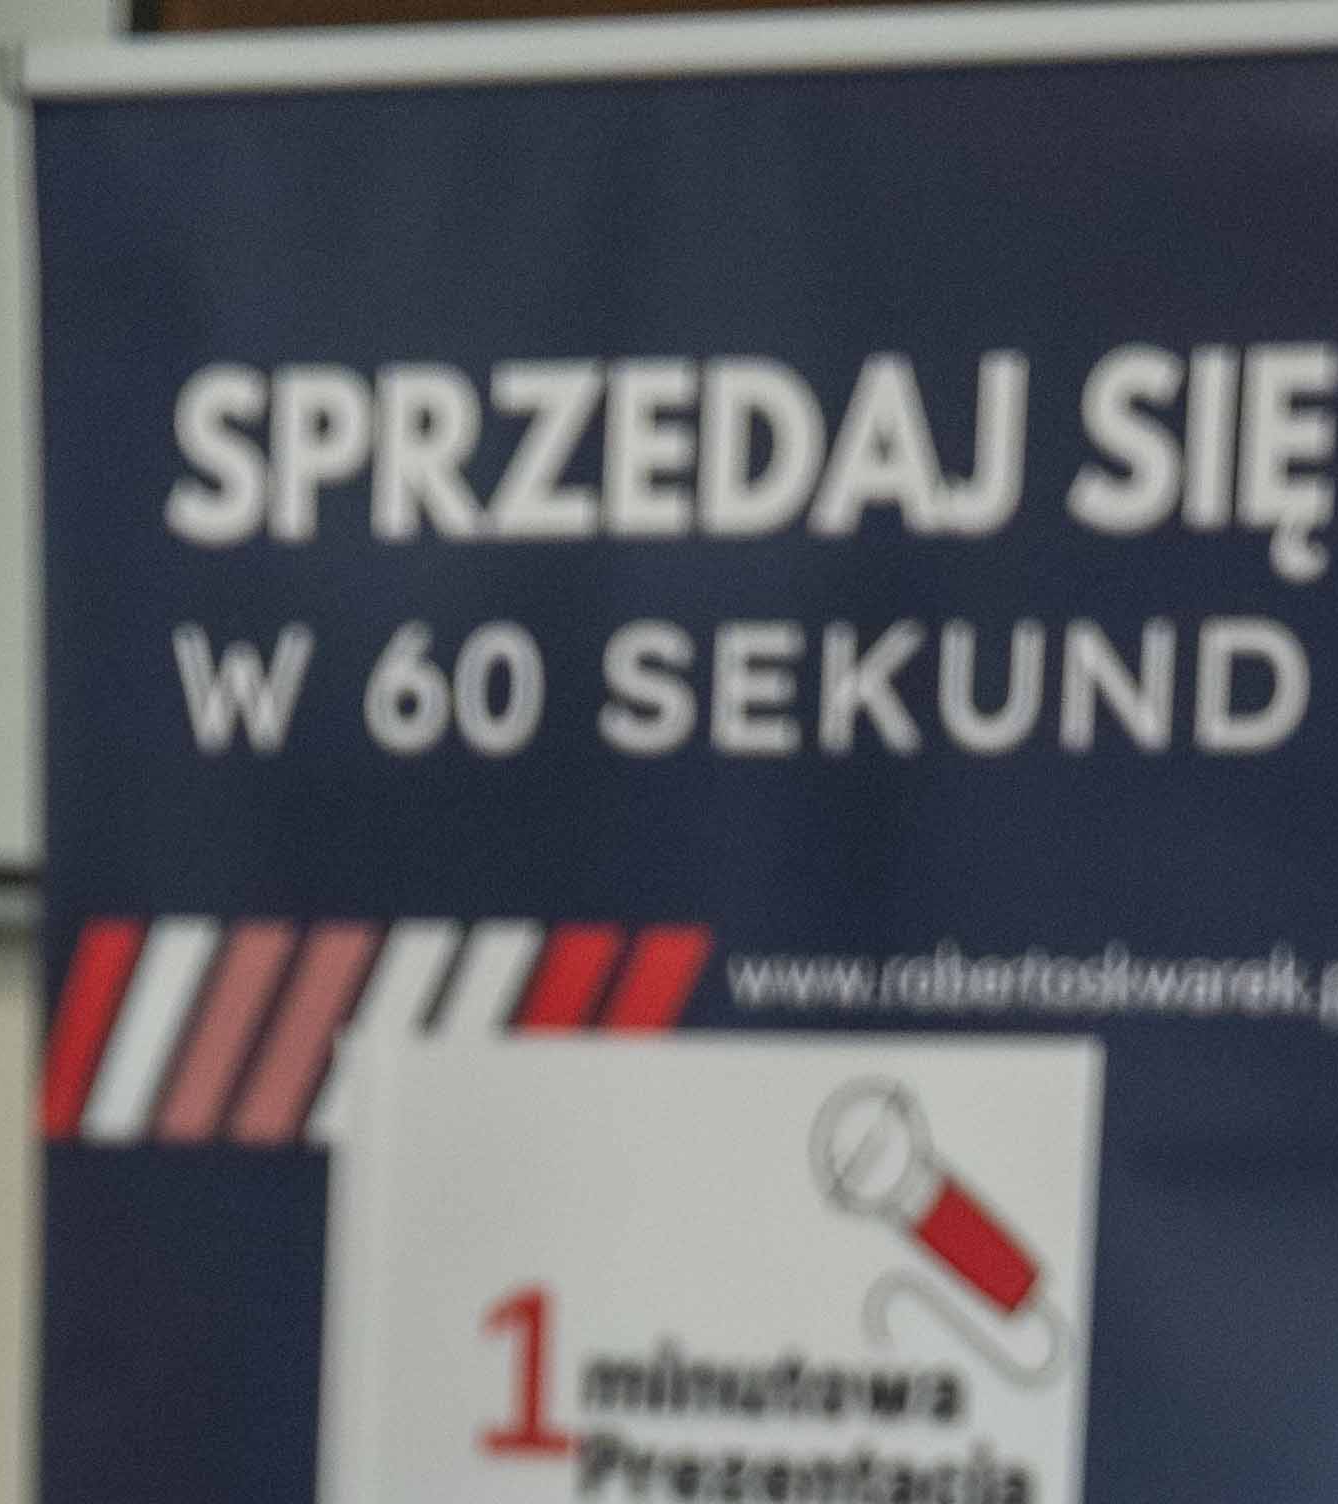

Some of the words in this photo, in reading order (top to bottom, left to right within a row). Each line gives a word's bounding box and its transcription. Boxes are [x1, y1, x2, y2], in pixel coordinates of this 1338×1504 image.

[167, 352, 1028, 545] SPRZEDAJ
[172, 623, 313, 751] W
[363, 621, 545, 754] 60
[598, 617, 1310, 754] SEKUND
[479, 1283, 576, 1461] 1
[581, 1340, 967, 1427] minutowa
